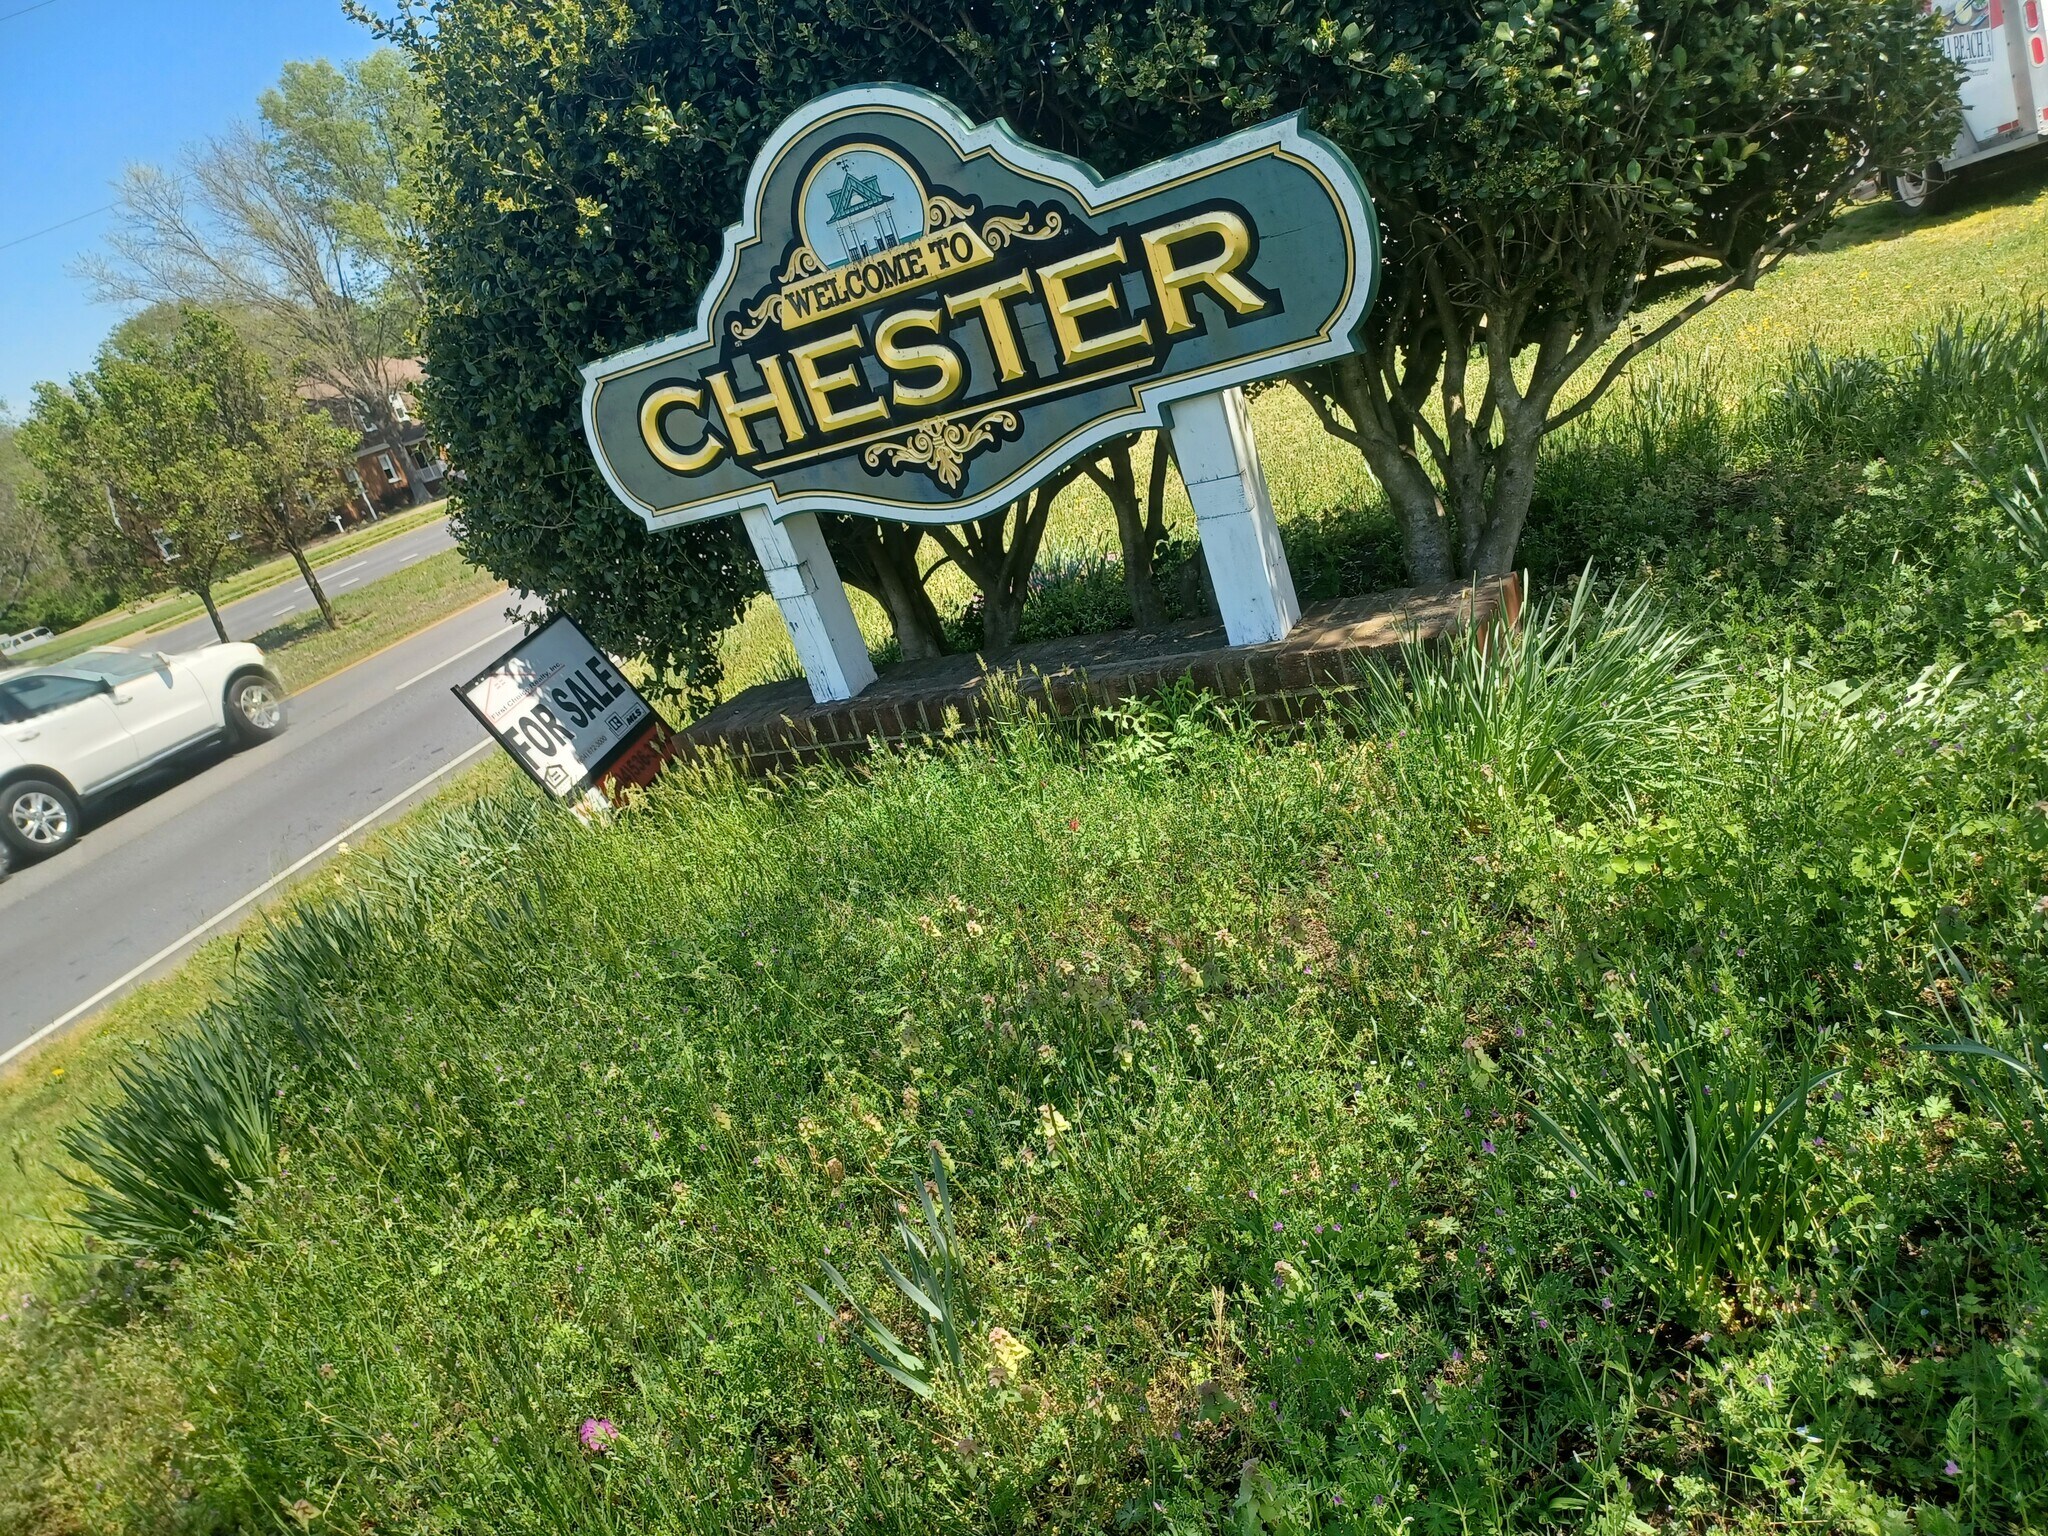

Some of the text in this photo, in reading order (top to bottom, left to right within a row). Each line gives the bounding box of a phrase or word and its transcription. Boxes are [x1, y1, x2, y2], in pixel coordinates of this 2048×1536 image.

[1954, 32, 1984, 59] BEACH
[785, 232, 974, 319] WELCOME TO
[640, 211, 1267, 471] CHESTER
[491, 706, 508, 719] First
[507, 687, 529, 706] Choice
[528, 671, 551, 689] Realty,
[502, 656, 626, 770] FOR SALE
[625, 708, 642, 726] MLS
